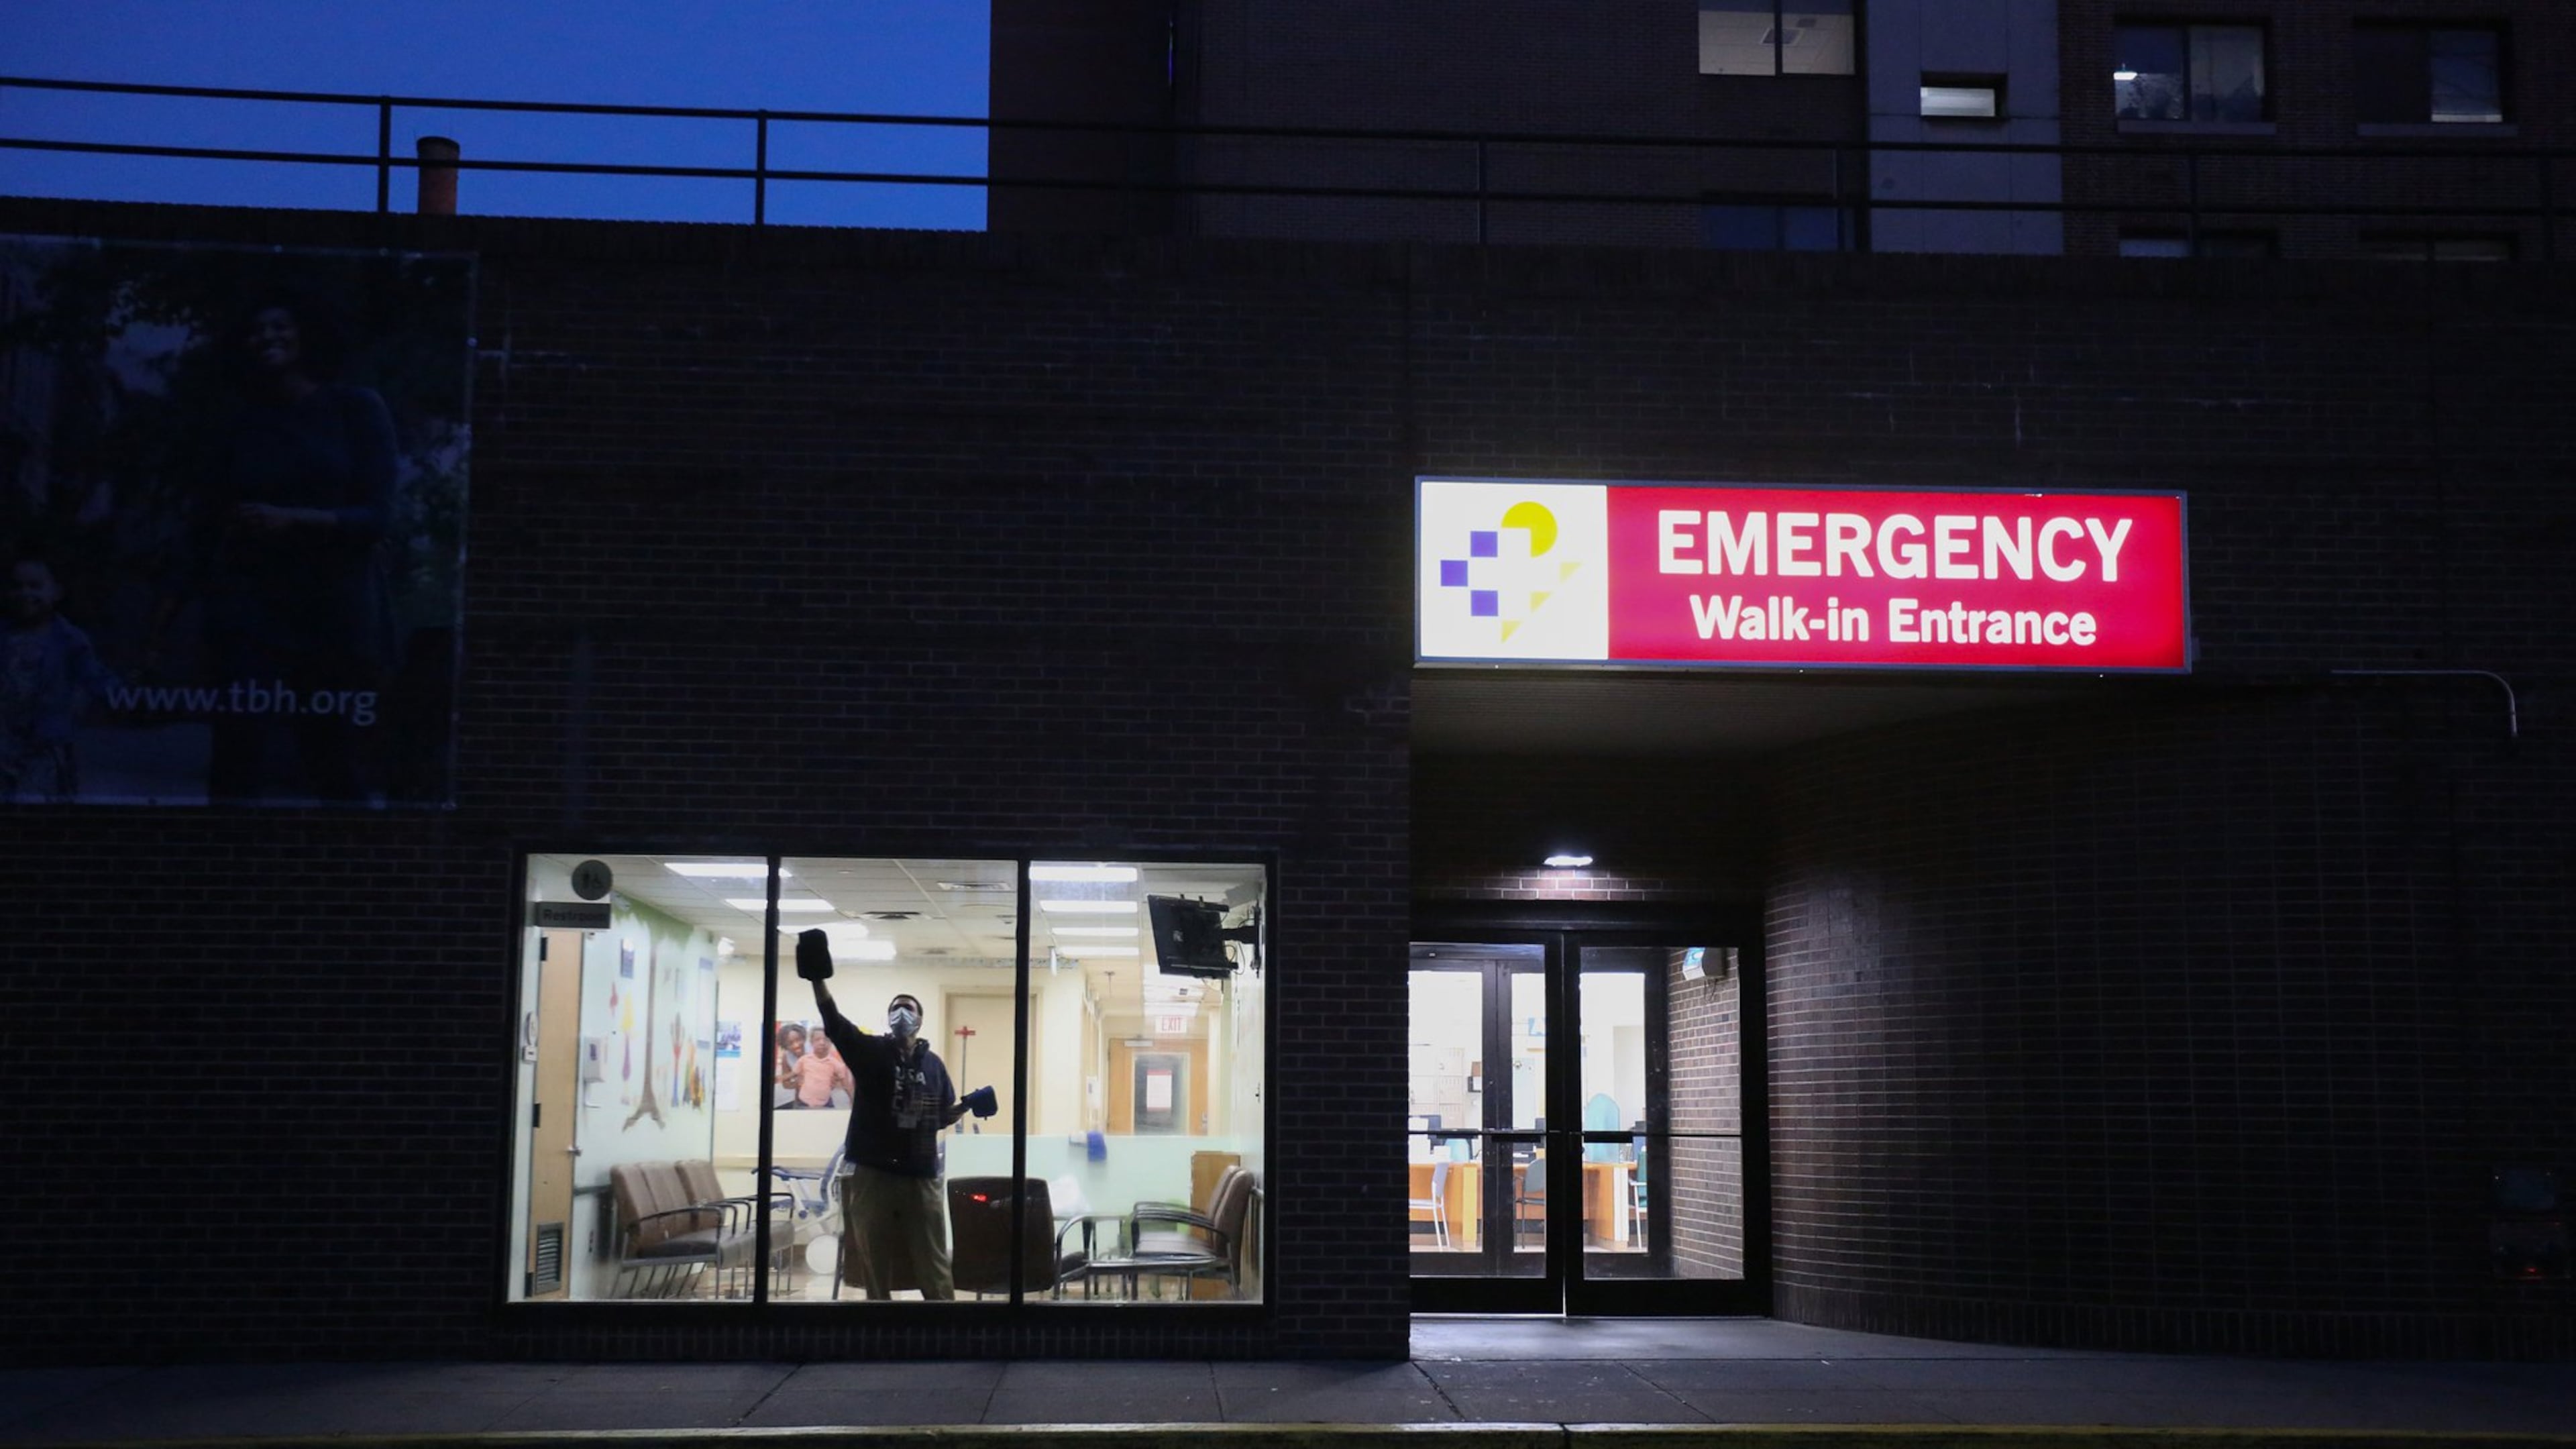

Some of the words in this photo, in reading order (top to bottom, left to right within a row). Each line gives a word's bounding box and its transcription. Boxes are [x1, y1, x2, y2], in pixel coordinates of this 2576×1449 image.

[1658, 509, 2133, 582] EMERGENCY
[1689, 594, 1870, 642] Walk-in
[1888, 598, 2096, 646] Entrance
[105, 679, 378, 727] www.tbh.org
[1161, 1017, 1183, 1031] EXIT
